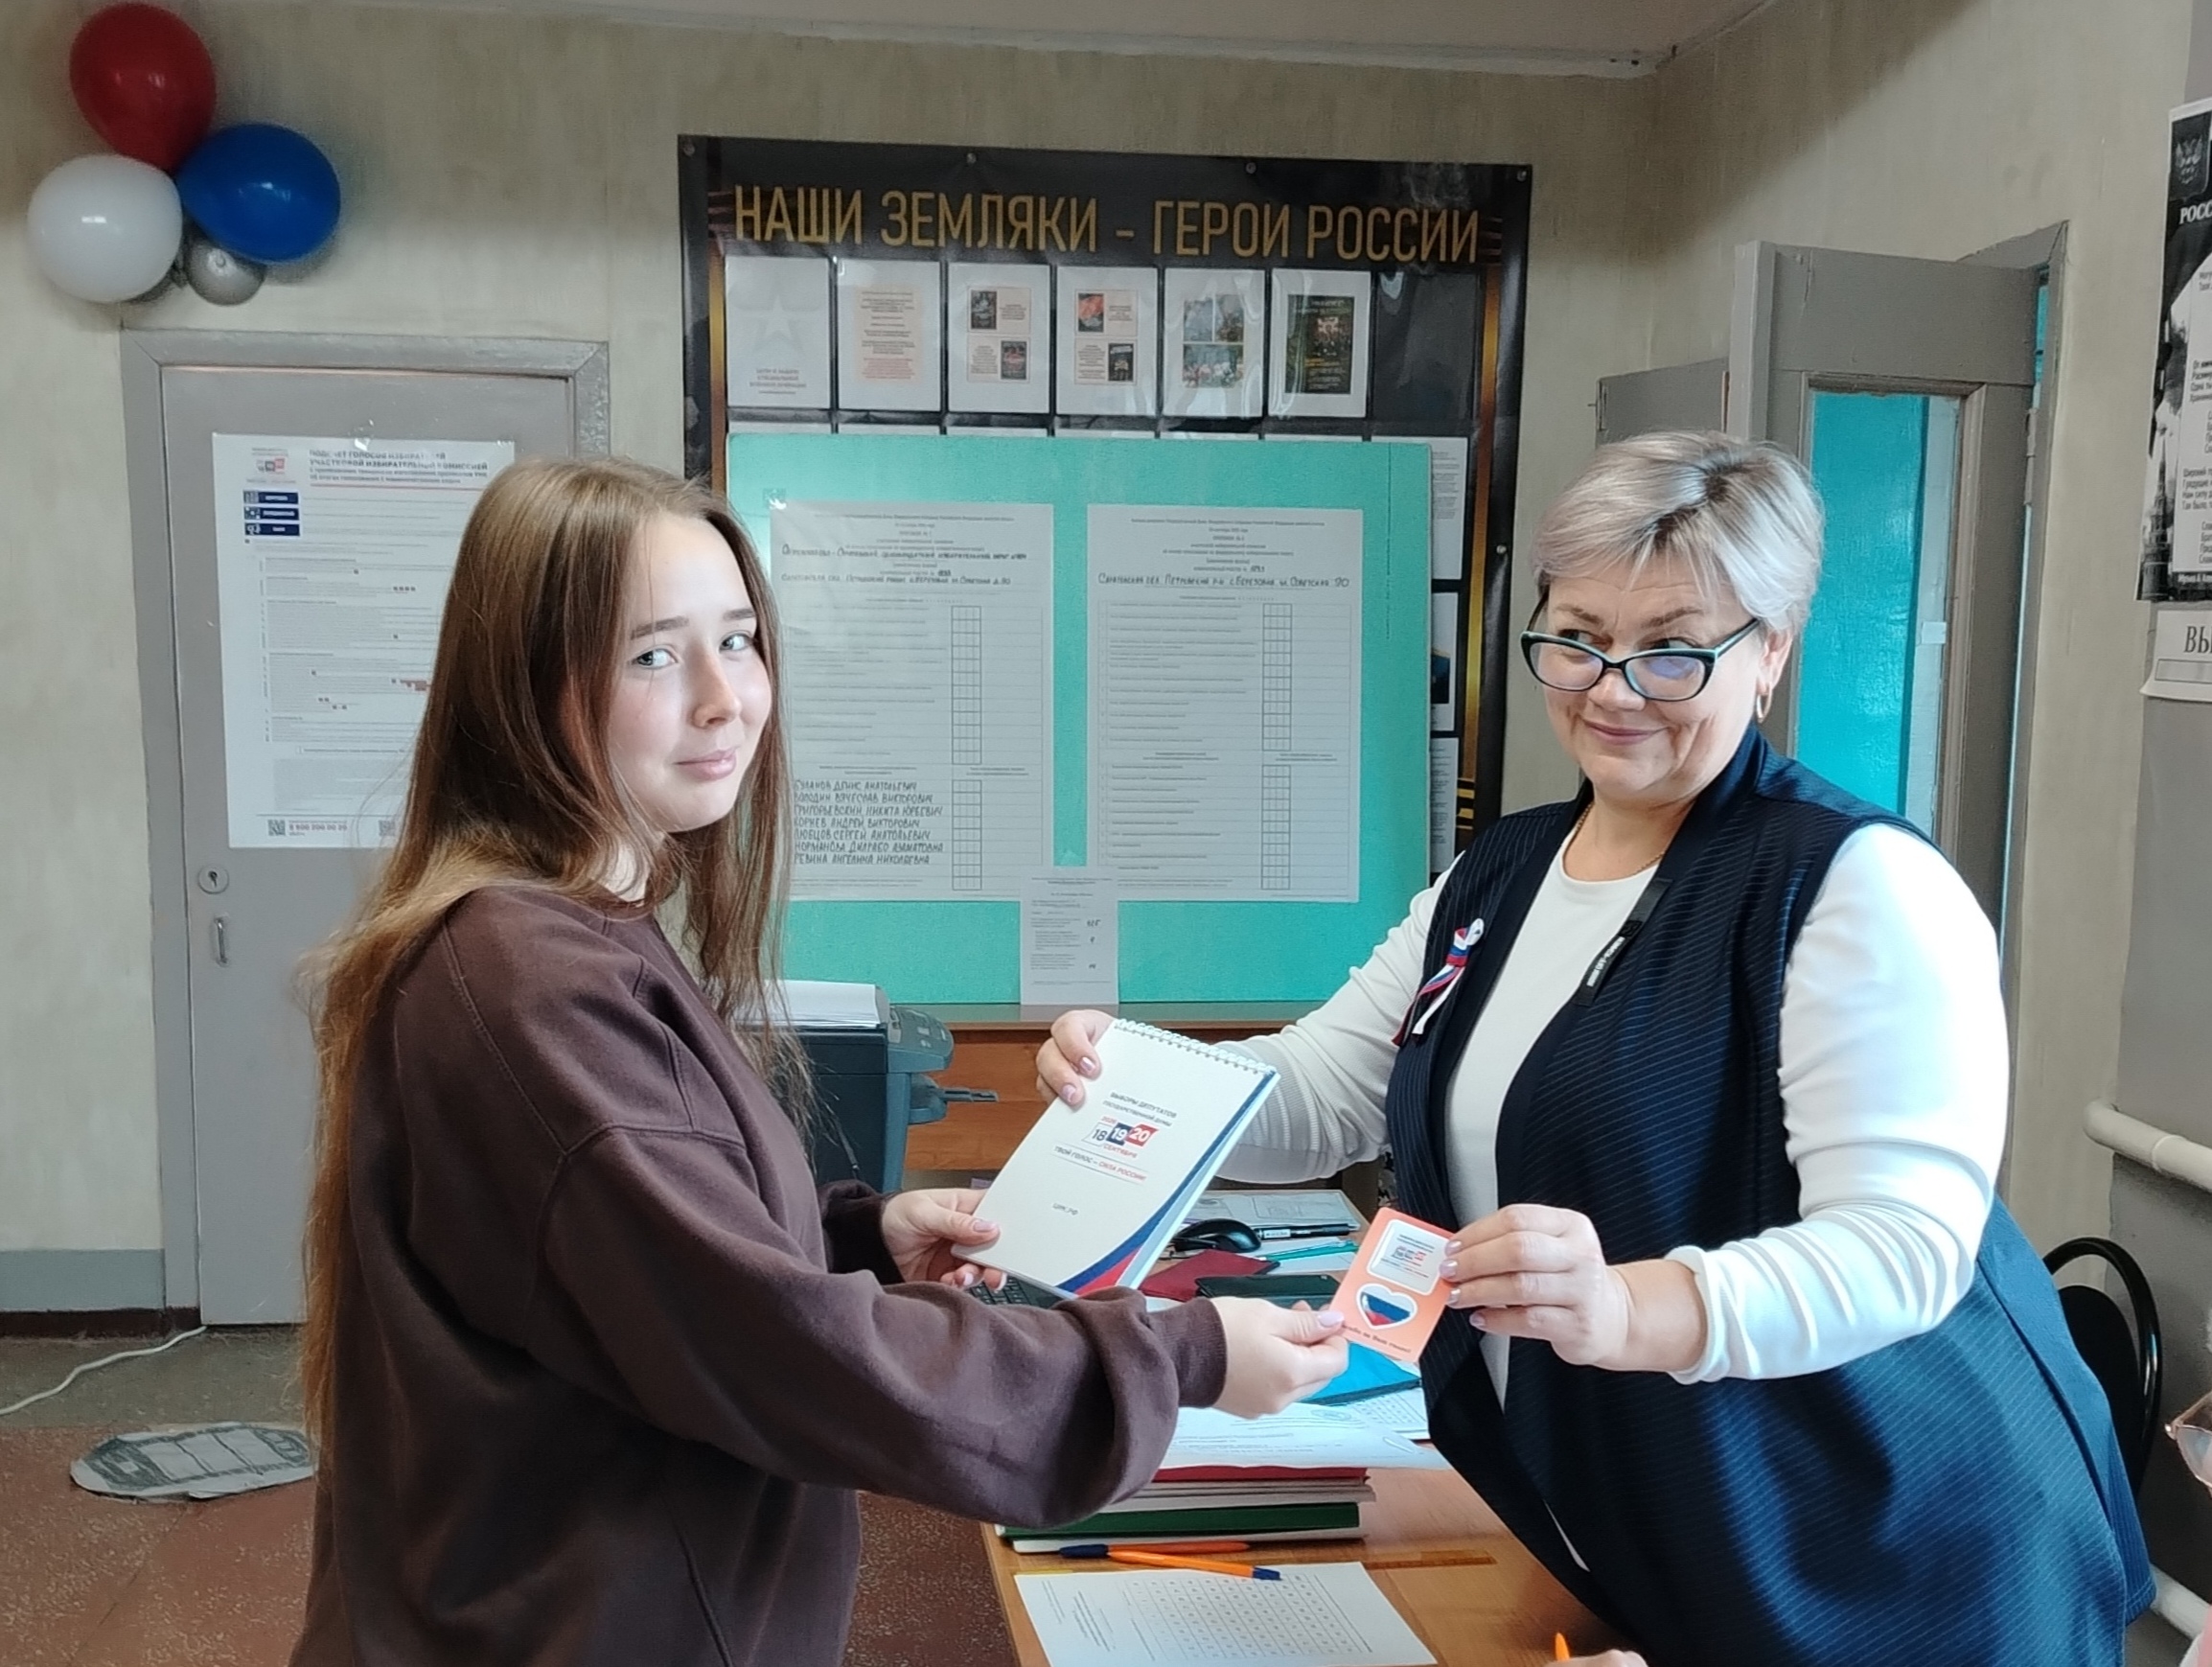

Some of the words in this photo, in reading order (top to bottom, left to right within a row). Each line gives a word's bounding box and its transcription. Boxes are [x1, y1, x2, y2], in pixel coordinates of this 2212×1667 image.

[734, 184, 863, 245] НАШИ
[880, 190, 1097, 253] ЗЕМЛЯКИ
[1153, 199, 1290, 259] ГЕРОИ
[1306, 204, 1479, 264] РОССИИ
[310, 450, 346, 459] ПОДСЕТ
[1092, 1128, 1108, 1142] 18
[1111, 1127, 1128, 1141] 19
[1128, 1127, 1152, 1142] 20
[1055, 1146, 1072, 1157] ТВОЙ
